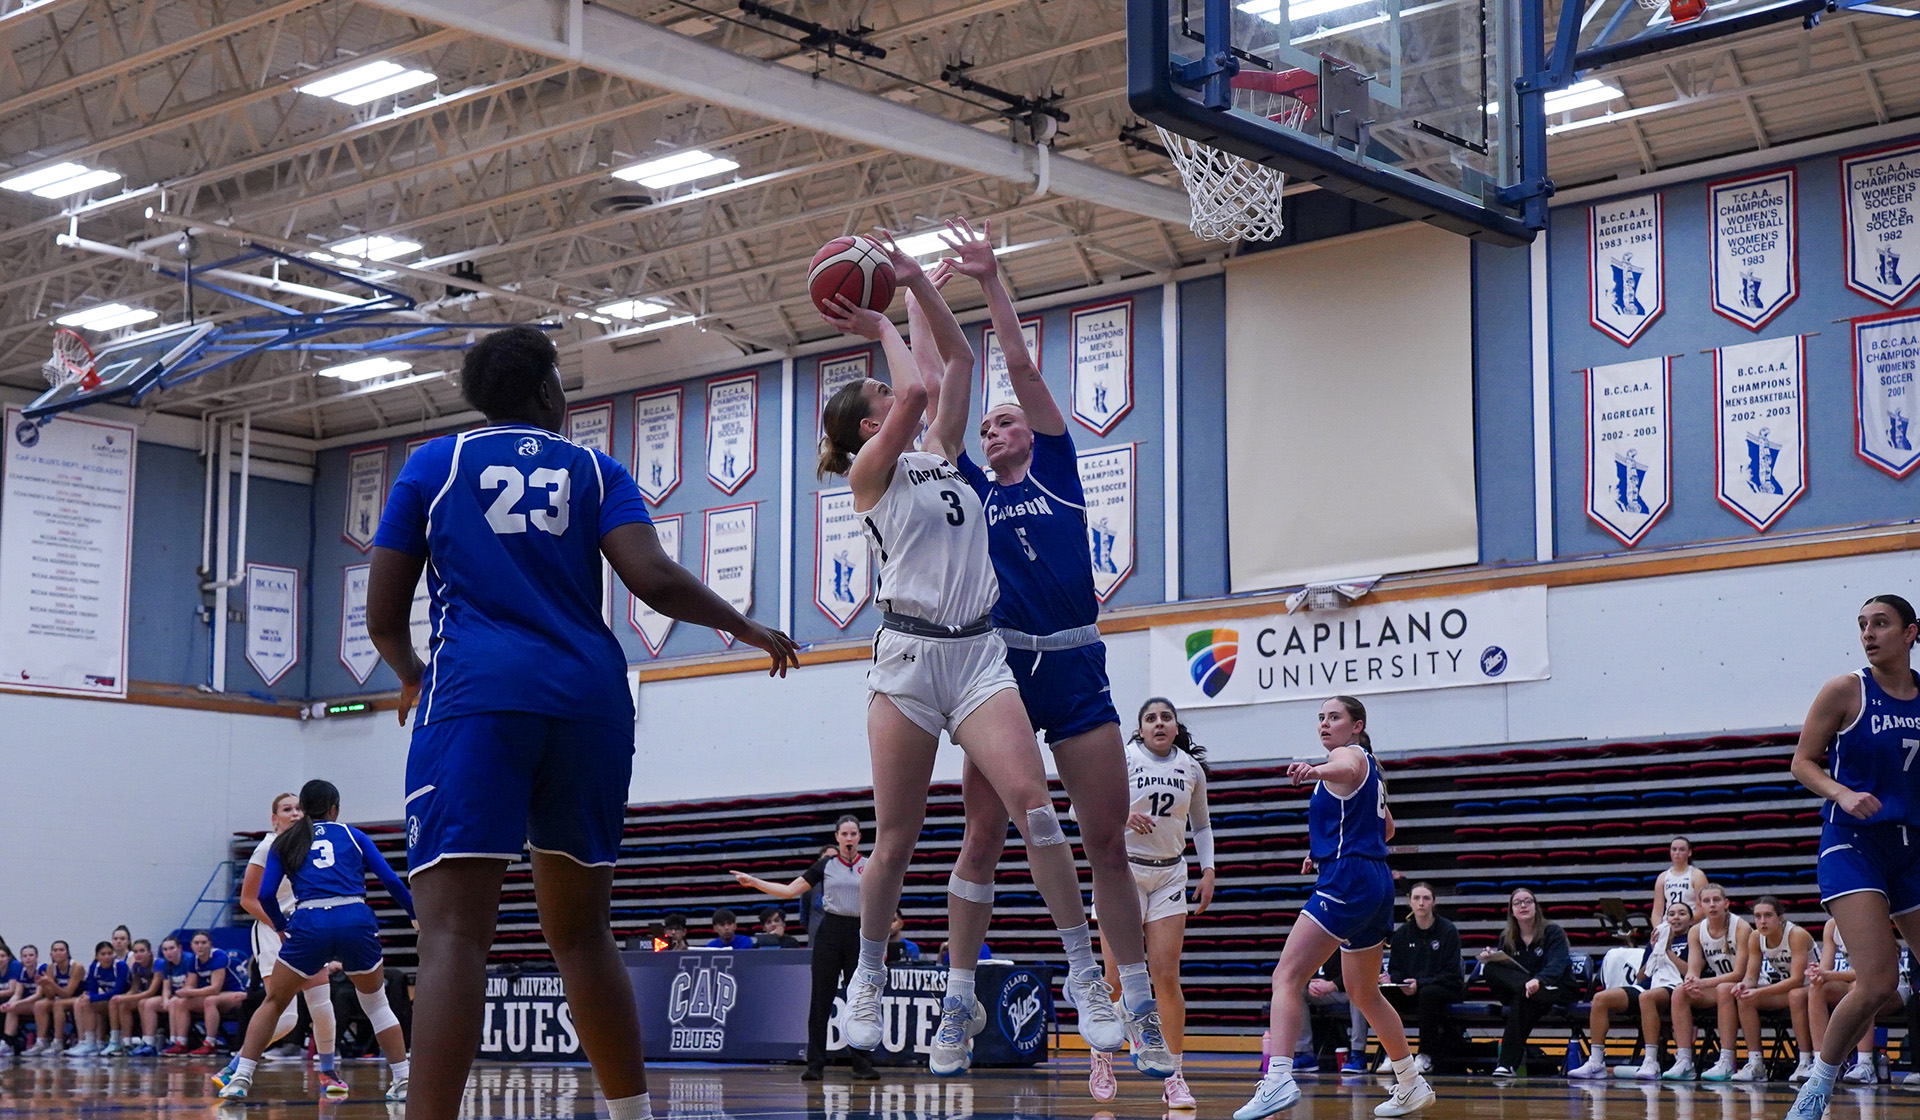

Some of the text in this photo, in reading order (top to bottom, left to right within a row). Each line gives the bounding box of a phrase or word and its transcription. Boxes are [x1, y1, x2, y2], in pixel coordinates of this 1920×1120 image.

[1867, 162, 1909, 176] T.C.A.A.
[1854, 168, 1920, 190] CHAMPIONS
[1733, 188, 1772, 204] T.C.A.A.
[1862, 182, 1916, 200] WOMEN'S
[1720, 196, 1784, 216] CHAMPIONS
[1865, 192, 1912, 210] SOCCER
[1600, 208, 1649, 224] B.C.C.A.A.
[1727, 208, 1778, 226] WOMEN'S
[1872, 207, 1907, 222] MEN'S
[1599, 218, 1653, 238] AGGREGATE
[1720, 217, 1784, 236] VOLLEYBALL
[1866, 214, 1914, 232] SOCCER
[1600, 238, 1622, 250] 1983
[1630, 232, 1653, 244] 1984
[1728, 230, 1779, 248] WOMEN'S
[1878, 230, 1902, 242] 1982
[1731, 240, 1776, 256] SOCCER
[1742, 254, 1765, 266] 1983
[1079, 328, 1124, 344] CHAMPIONS
[1871, 335, 1920, 350] B.C.C.A.A.
[1078, 350, 1124, 364] BASKETBALL
[1866, 348, 1920, 363] CHAMPION
[1737, 362, 1788, 377] B.C.C.A.A.
[1877, 360, 1916, 374] WOMEN'S
[1731, 377, 1792, 394] CHAMPIONS
[1880, 372, 1914, 386] SOCCER
[1604, 382, 1652, 396] B.C.C.A.A.
[1887, 386, 1906, 398] 2001
[1725, 390, 1796, 408] MEN'S BASKETBALL
[1601, 406, 1656, 422] AGGREGATE
[1731, 410, 1756, 422] 2002
[1766, 406, 1791, 418] 2003
[1601, 430, 1624, 442] 2002
[1633, 426, 1657, 437] 2003
[1081, 468, 1124, 482] CHAMPIONS
[1101, 482, 1126, 492] SOCCER
[480, 465, 570, 536] 23
[940, 490, 965, 526] 3
[1086, 500, 1100, 508] 003
[826, 514, 854, 523] AGGREGA
[714, 545, 748, 555] CHAMPIONS
[1256, 608, 1468, 658] CAPILANO
[1258, 648, 1463, 690] UNIVERSITY
[1871, 714, 1920, 735] CAMOS
[1902, 738, 1920, 772] 7
[1137, 776, 1185, 792] CAPILANO
[1148, 792, 1175, 817] 12
[310, 840, 336, 868] 3
[1670, 891, 1683, 903] 21
[1715, 959, 1734, 974] 10
[513, 977, 566, 996] UNIVERSI
[890, 969, 948, 992] UNIVERS
[669, 969, 736, 1023] CAP
[1002, 974, 1028, 1008] CAPILANO
[481, 1002, 580, 1054] LUES
[672, 1029, 724, 1050] BLUES
